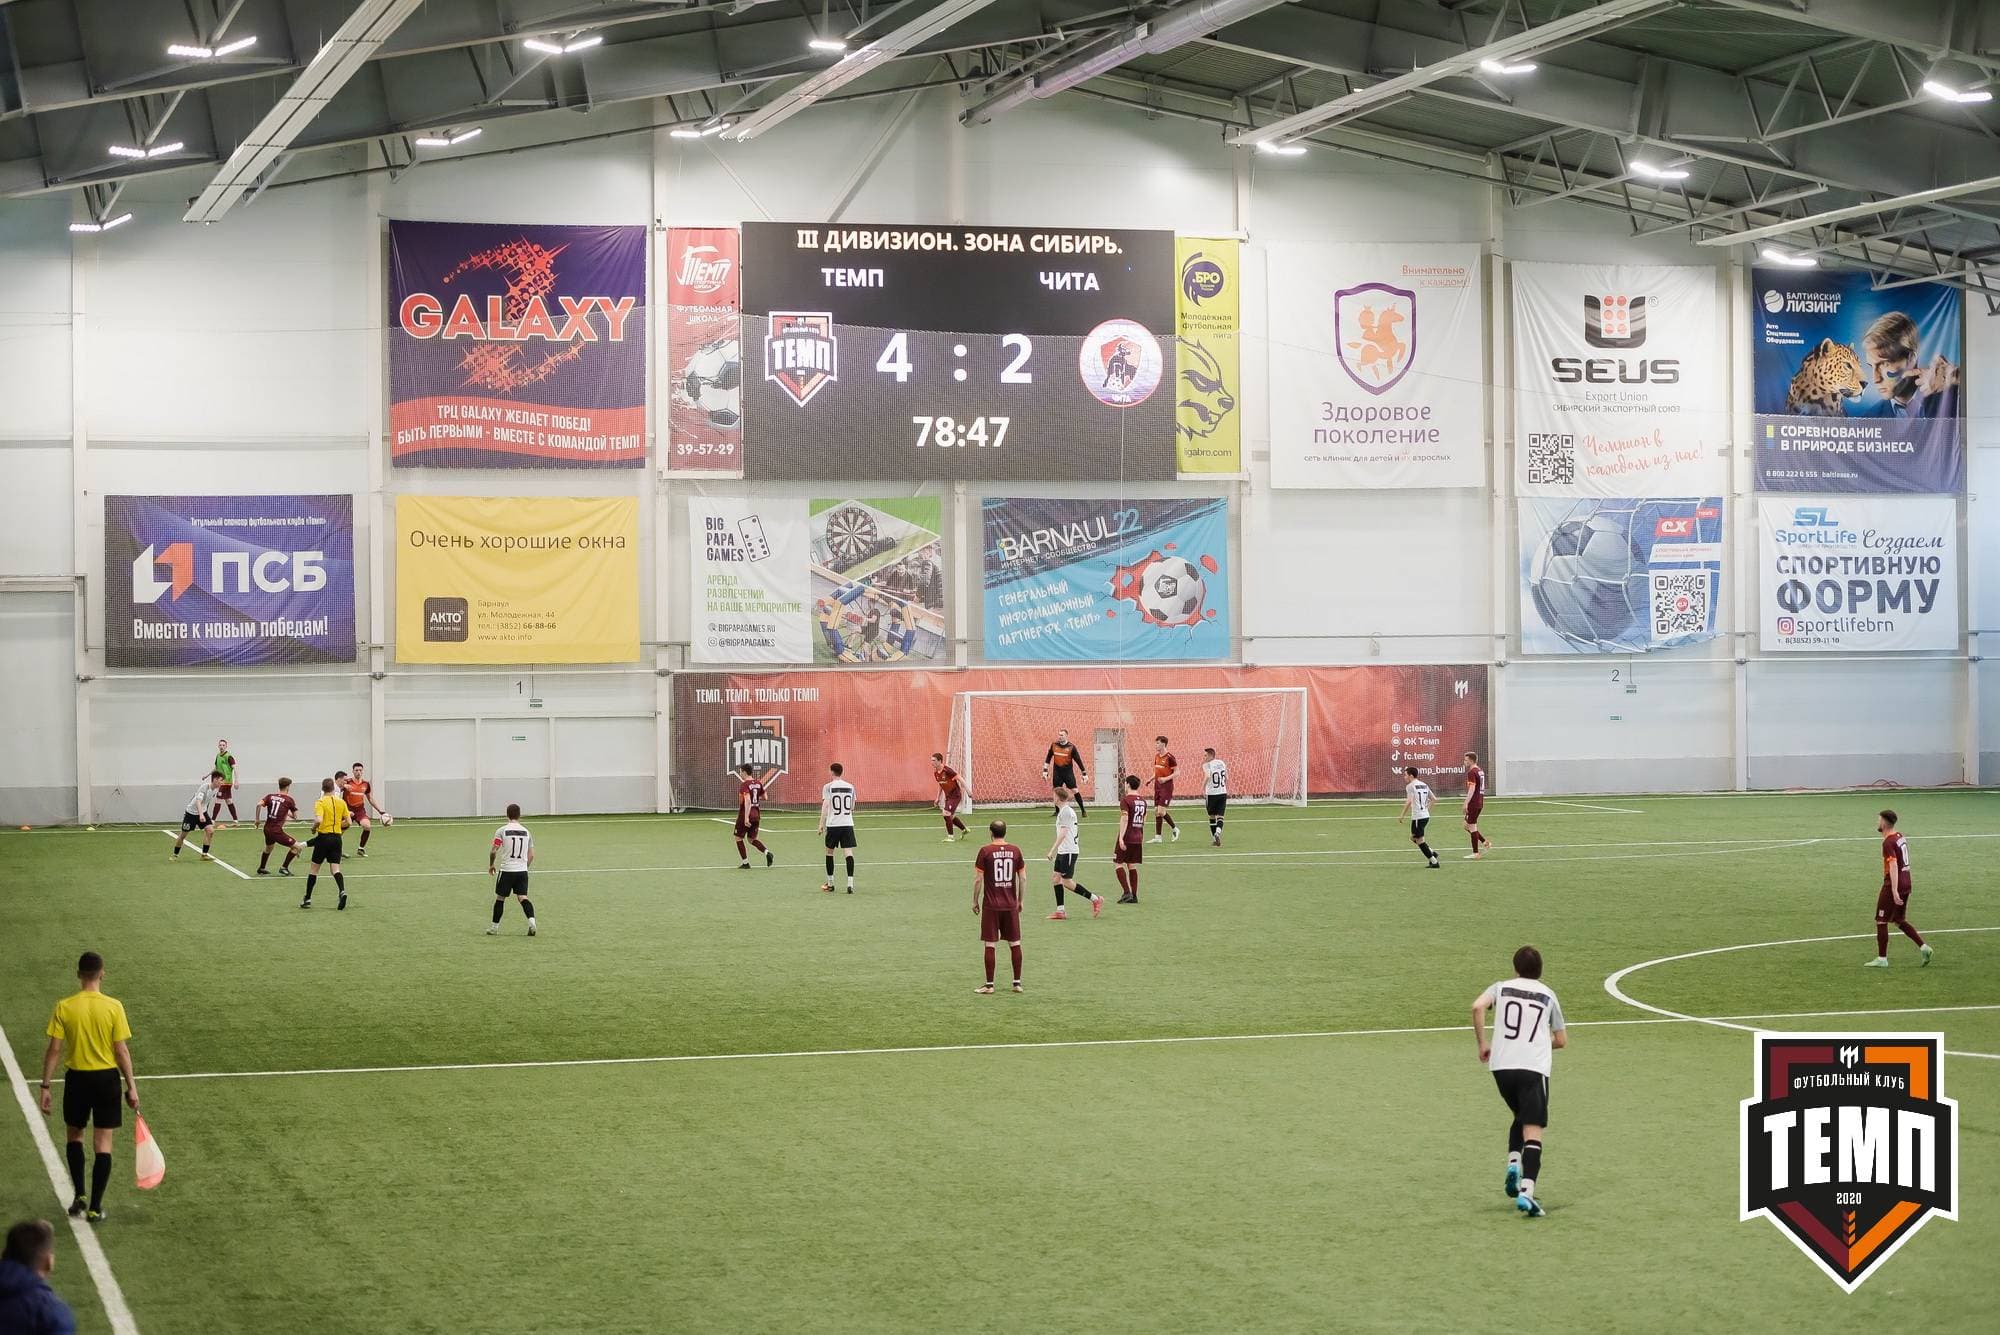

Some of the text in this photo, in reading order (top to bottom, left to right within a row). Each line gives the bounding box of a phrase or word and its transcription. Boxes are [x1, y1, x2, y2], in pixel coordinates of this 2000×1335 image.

[797, 230, 1122, 255] III ДИВИЗИОН. ЗОНА СИБИРЬ.
[821, 267, 884, 288] ТЕМП
[1402, 265, 1464, 274] Внимательно
[1039, 271, 1100, 291] ЧИТА
[1787, 292, 1841, 300] БАЛТИЙСКИЙ
[399, 293, 635, 341] GALAXY
[1786, 301, 1841, 313] ЛИЗИНГ
[1183, 322, 1231, 330] футбольная
[772, 338, 831, 372] ТЕМП
[876, 332, 913, 382] 4
[1000, 333, 1033, 384] 2
[1552, 357, 1680, 384] SEUS
[1585, 391, 1648, 402] Export Union
[1322, 401, 1431, 423] Здоровое
[1553, 403, 1600, 412] СИБИРСКИЙ
[1602, 404, 1656, 413] ЭКСПОРТНЫЙ
[437, 405, 591, 432] ТРЦ GALAXY ЖЕЛАЕТ ПОБЕД!
[398, 426, 426, 444] БЫТЬ
[430, 425, 482, 439] ПЕРВЫМИ
[493, 428, 534, 445] ВМЕСТЕ
[538, 433, 544, 446] С
[548, 434, 606, 451] КОМАНДОЙ
[610, 436, 640, 449] ТЕМП!
[913, 416, 1010, 447] 78:47
[1314, 428, 1440, 444] поколение
[1781, 425, 1882, 438] СОРЕВНОВАНИЕ
[677, 443, 735, 456] 39-57-29
[1583, 433, 1650, 456] Чемпион
[1781, 441, 1914, 454] В ПРИРОДЕ БИЗНЕСА
[1586, 454, 1649, 477] каждом
[1653, 456, 1672, 470] из
[191, 516, 223, 528] Титульный
[249, 517, 286, 527] футбольного
[706, 517, 724, 531] BIG
[1793, 507, 1839, 527] SL
[410, 530, 626, 553] Очень хорошие окна
[706, 532, 734, 547] PAPA
[1776, 530, 1857, 546] SportLife
[1862, 529, 1945, 554] Создаем
[706, 547, 744, 562] GAMES
[1001, 542, 1096, 569] ИНТЕРНЕТ СООБЩЕСТВО
[212, 550, 327, 593] ПСБ
[1776, 555, 1941, 575] СПОРТИВНУЮ
[707, 574, 738, 585] АРЕНДА
[998, 581, 1068, 607] ГЕНЕРАЛЬНЫЙ
[1777, 579, 1940, 614] ФОРМУ
[707, 602, 801, 613] НА ВАШЕ МЕРОПРИЯТИЕ
[999, 594, 1094, 627] ИНФОРМАЦИОННЫЙ
[134, 616, 328, 640] Вместе к новым победам!
[497, 622, 521, 630] (3852)
[999, 613, 1101, 646] ПАРТНЕР ФК «ТЕМП»
[1797, 617, 1894, 635] sportlifebrn
[718, 637, 775, 647] @BIGPAPAGAMES
[1612, 670, 1619, 681] 2
[516, 681, 521, 694] 1
[696, 688, 819, 705] ТЕМП, ТЕМП, ТОЛЬКО ТЕМП!
[1404, 724, 1442, 733] fctemp.ru
[733, 738, 782, 766] ТЕМП
[1404, 752, 1434, 761] fc.temp
[272, 800, 281, 817] 11
[832, 795, 851, 815] 99
[1133, 806, 1144, 823] 23
[510, 837, 523, 859] 11
[994, 858, 1013, 882] 60
[1504, 1001, 1544, 1042] 97
